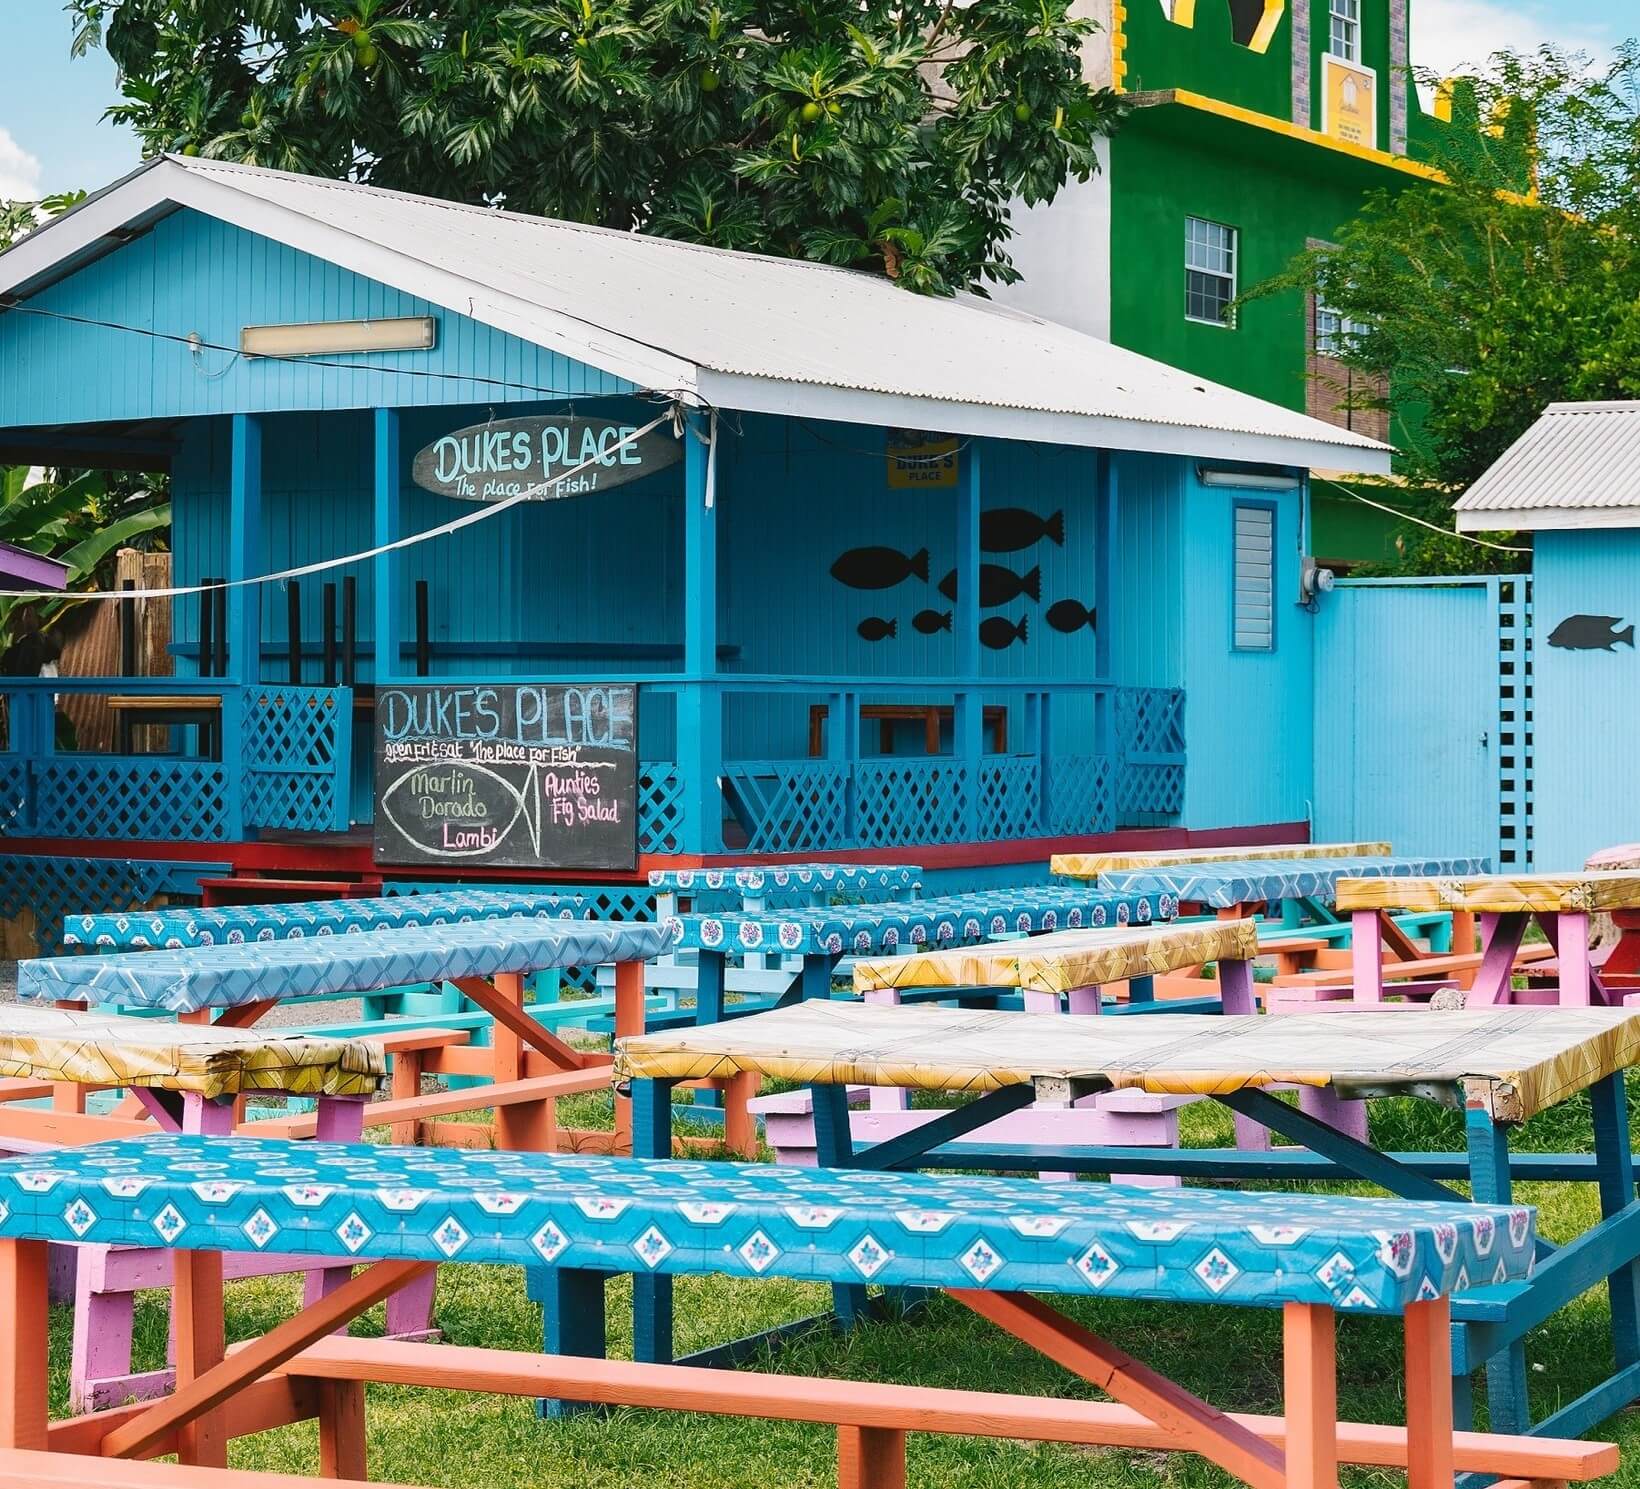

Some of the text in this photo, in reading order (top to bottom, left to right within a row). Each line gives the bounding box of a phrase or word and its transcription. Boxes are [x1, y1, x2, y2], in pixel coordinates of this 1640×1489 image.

[433, 426, 642, 483] DUKES PLACE
[455, 474, 476, 496] The
[482, 478, 520, 499] place
[556, 473, 598, 498] Fish!
[908, 471, 943, 481] PLACE
[380, 687, 631, 745] DUKE'S PLACE
[411, 769, 476, 796] Marlin
[545, 771, 600, 798] Aunties
[419, 797, 487, 819] Dorado
[551, 796, 620, 826] Fig Salad
[443, 822, 498, 849] Lambi
